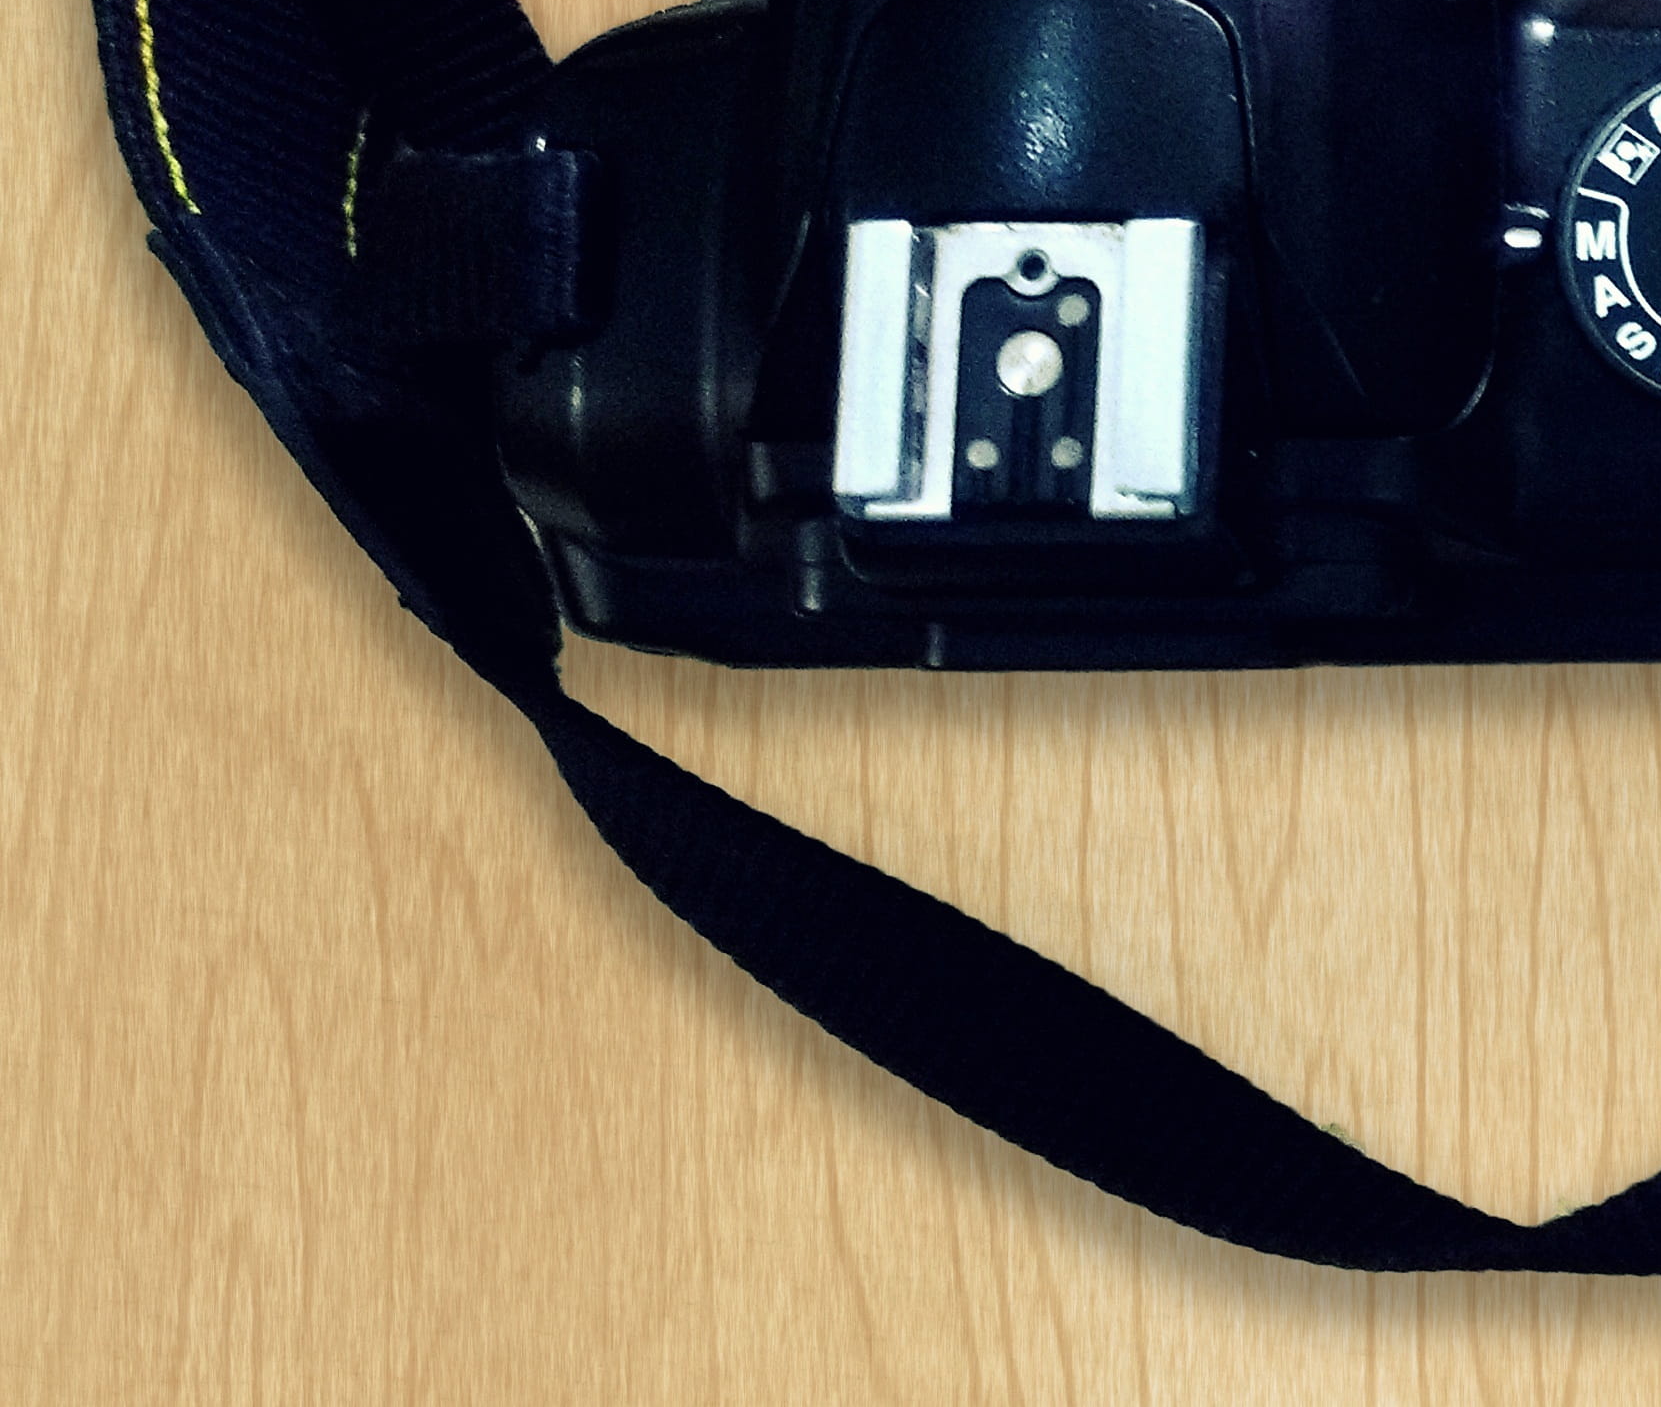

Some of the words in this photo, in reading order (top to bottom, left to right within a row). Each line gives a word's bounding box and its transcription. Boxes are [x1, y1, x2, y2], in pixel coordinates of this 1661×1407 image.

[1575, 220, 1617, 262] M
[1593, 274, 1631, 318] A
[1615, 321, 1657, 360] S
